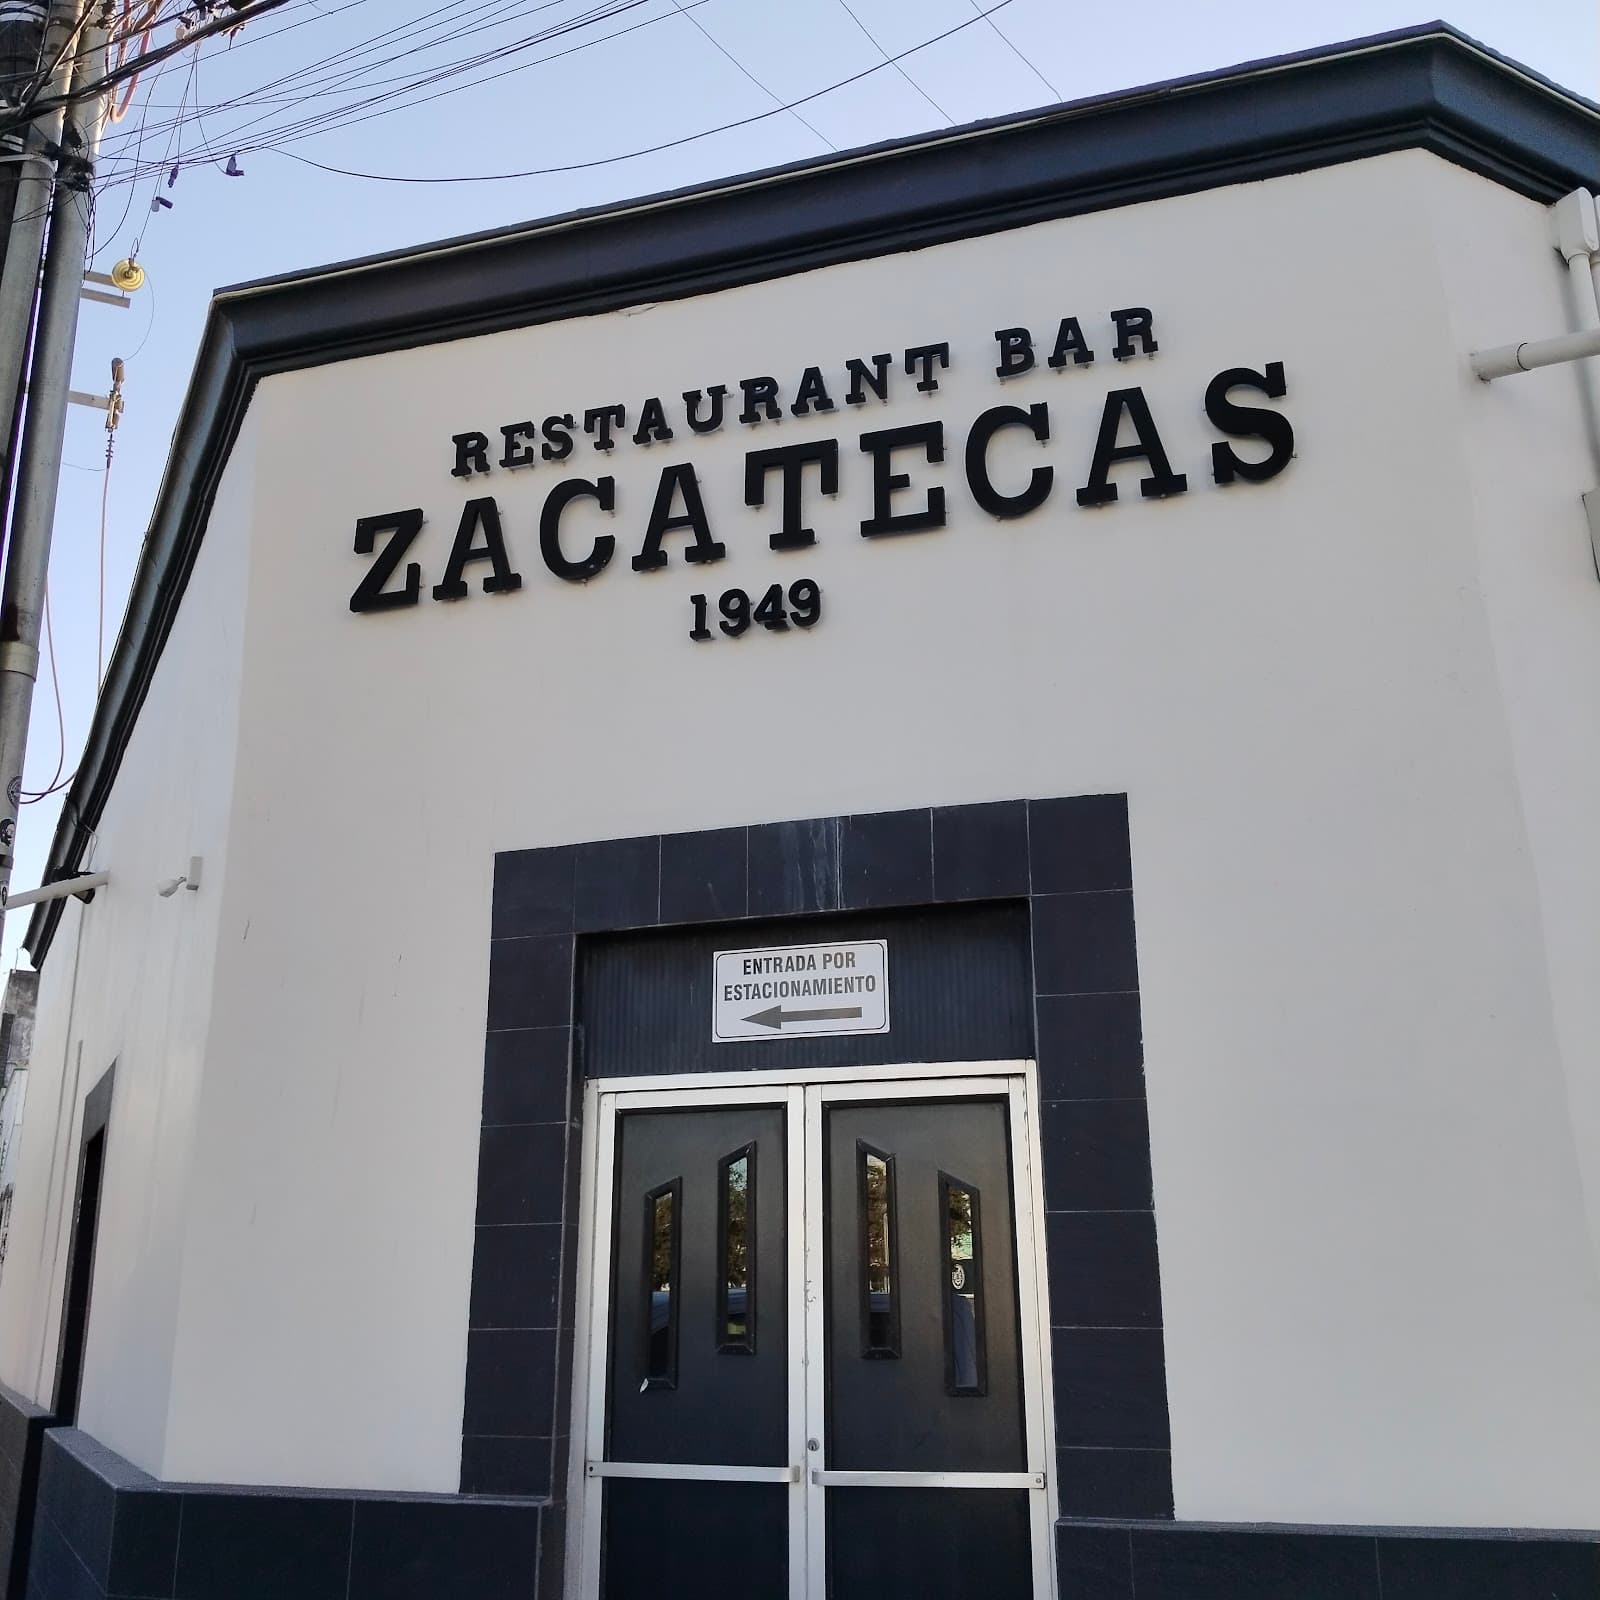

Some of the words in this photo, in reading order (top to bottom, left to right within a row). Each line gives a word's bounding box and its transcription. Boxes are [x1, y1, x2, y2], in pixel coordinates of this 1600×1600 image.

[451, 342, 949, 477] RESTAURANT
[995, 308, 1158, 375] BAR
[350, 362, 1296, 613] ZACATECAS
[690, 579, 820, 641] 1949
[724, 975, 876, 1002] ESTACIONAMIENTO
[743, 954, 816, 976] ENTRADA
[822, 951, 856, 970] POR
